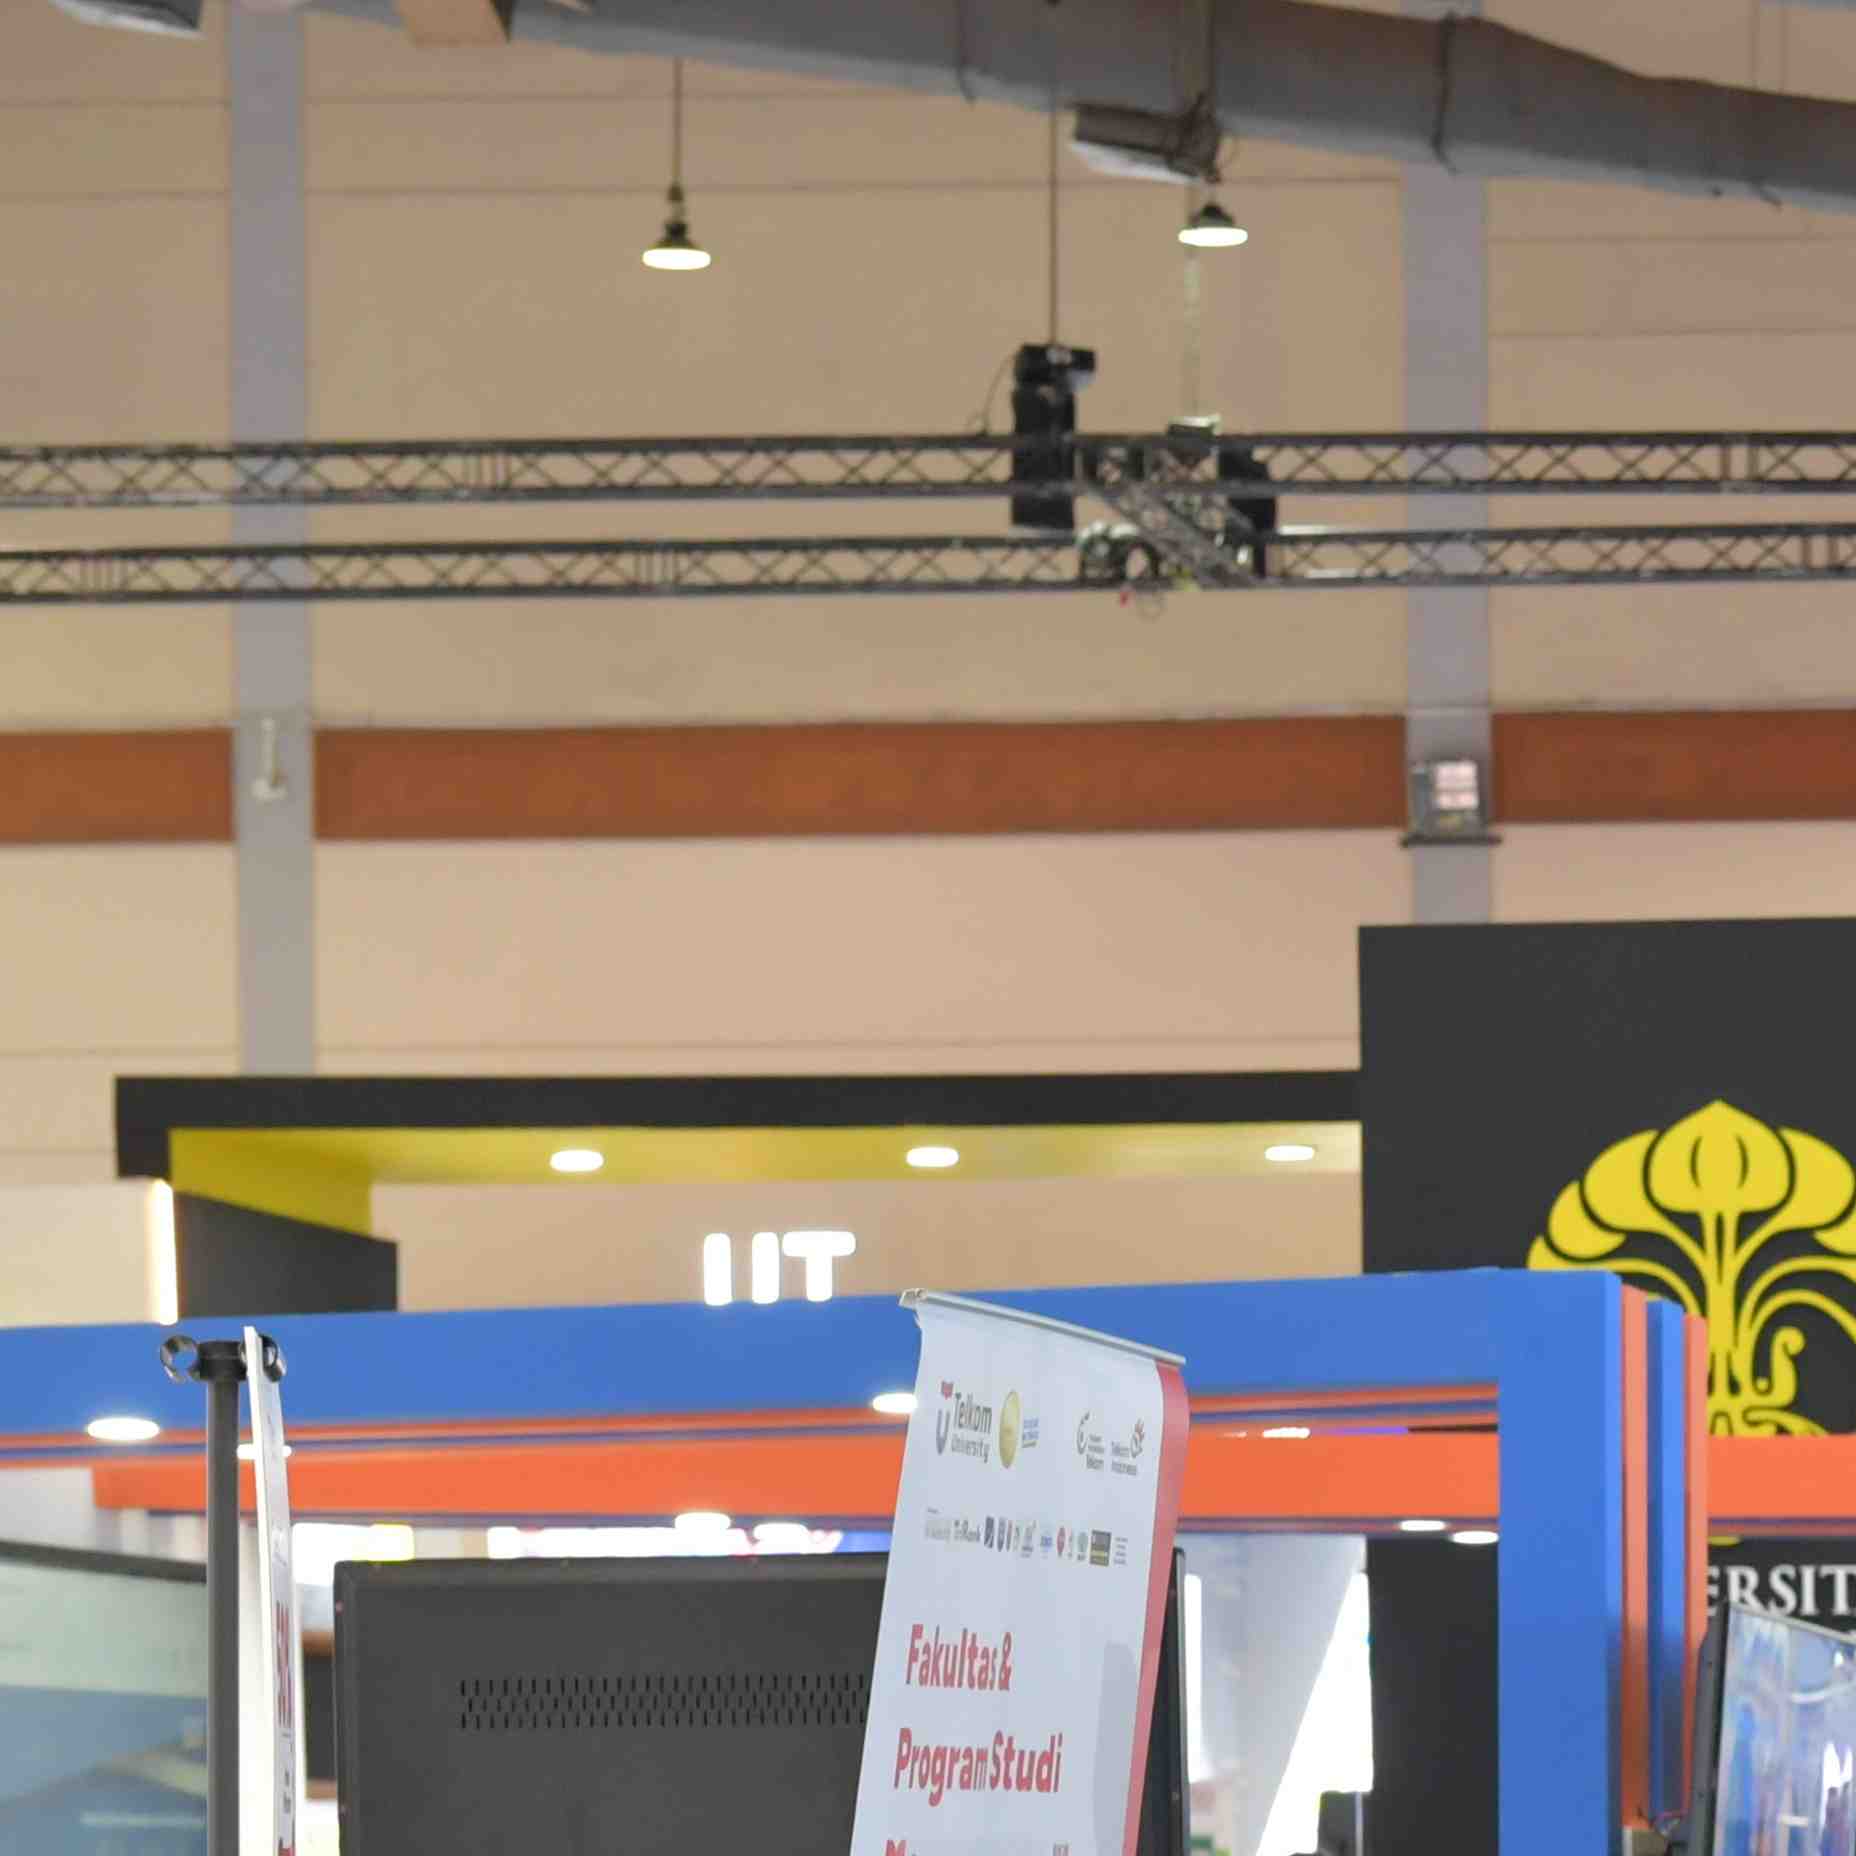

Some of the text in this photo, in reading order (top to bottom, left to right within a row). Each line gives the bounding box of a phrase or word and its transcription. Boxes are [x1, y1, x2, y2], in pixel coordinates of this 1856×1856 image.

[954, 1392, 993, 1434] Telkom
[951, 1434, 990, 1463] University
[905, 1623, 1012, 1691] Fakultas &
[894, 1727, 1063, 1807] Program Studi
